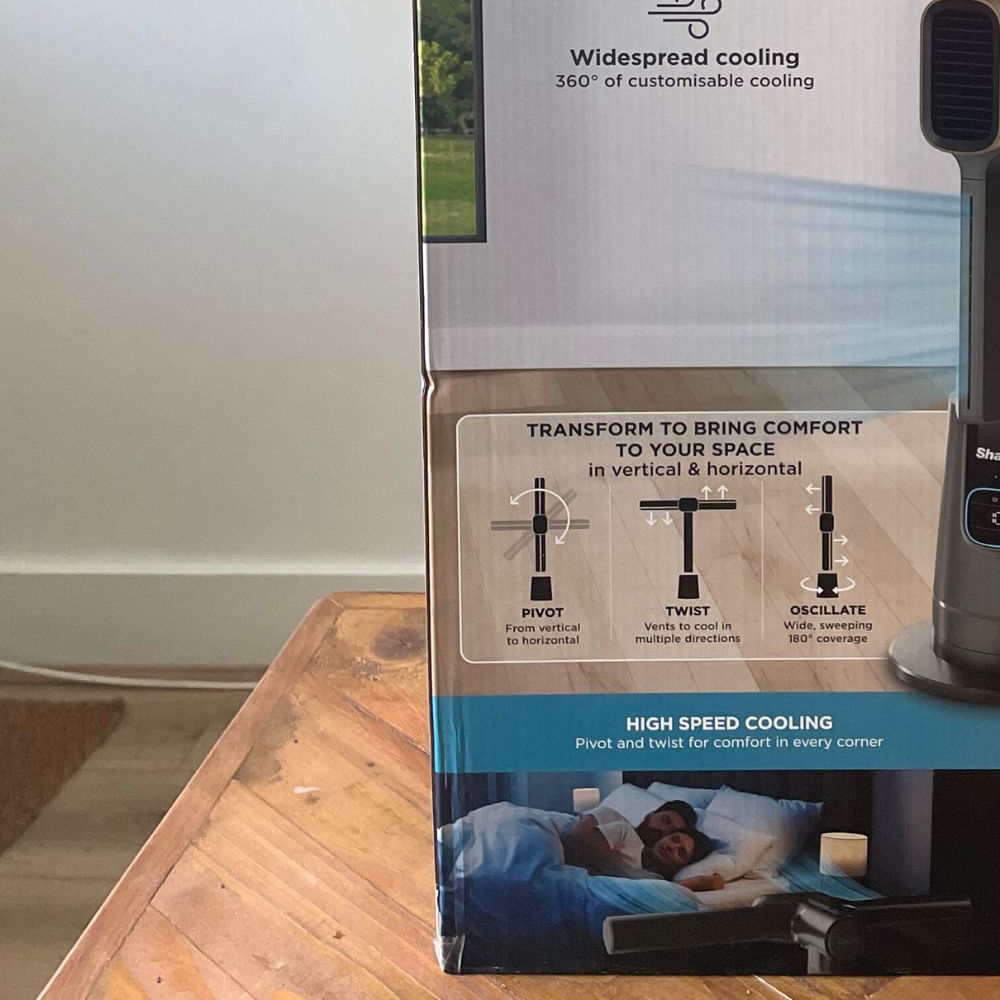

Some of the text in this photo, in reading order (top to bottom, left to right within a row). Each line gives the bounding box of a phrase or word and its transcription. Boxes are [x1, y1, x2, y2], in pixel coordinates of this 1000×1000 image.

[570, 49, 800, 69] Widespread cooling
[604, 74, 622, 88] of
[628, 74, 744, 88] customisable
[750, 74, 814, 90] cooling
[527, 420, 863, 438] TRANSFORM TO BRING COMFORT
[616, 443, 775, 457] TO YOUR SPACE
[589, 461, 802, 477] in vertical & horizontal
[522, 607, 564, 618] PIVOT
[665, 606, 710, 617] TWIST
[790, 605, 866, 616] OSCILLATE
[505, 623, 580, 632] From vertical
[644, 621, 731, 631] Vents to cool in
[784, 620, 872, 632] Wide, sweeping
[507, 635, 580, 645] to horizontal
[635, 634, 740, 645] multiple directions
[817, 634, 868, 645] coverage
[625, 715, 833, 731] HIGH SPEED COOLING
[575, 735, 883, 751] Pivot and twist for comfort in every corner
